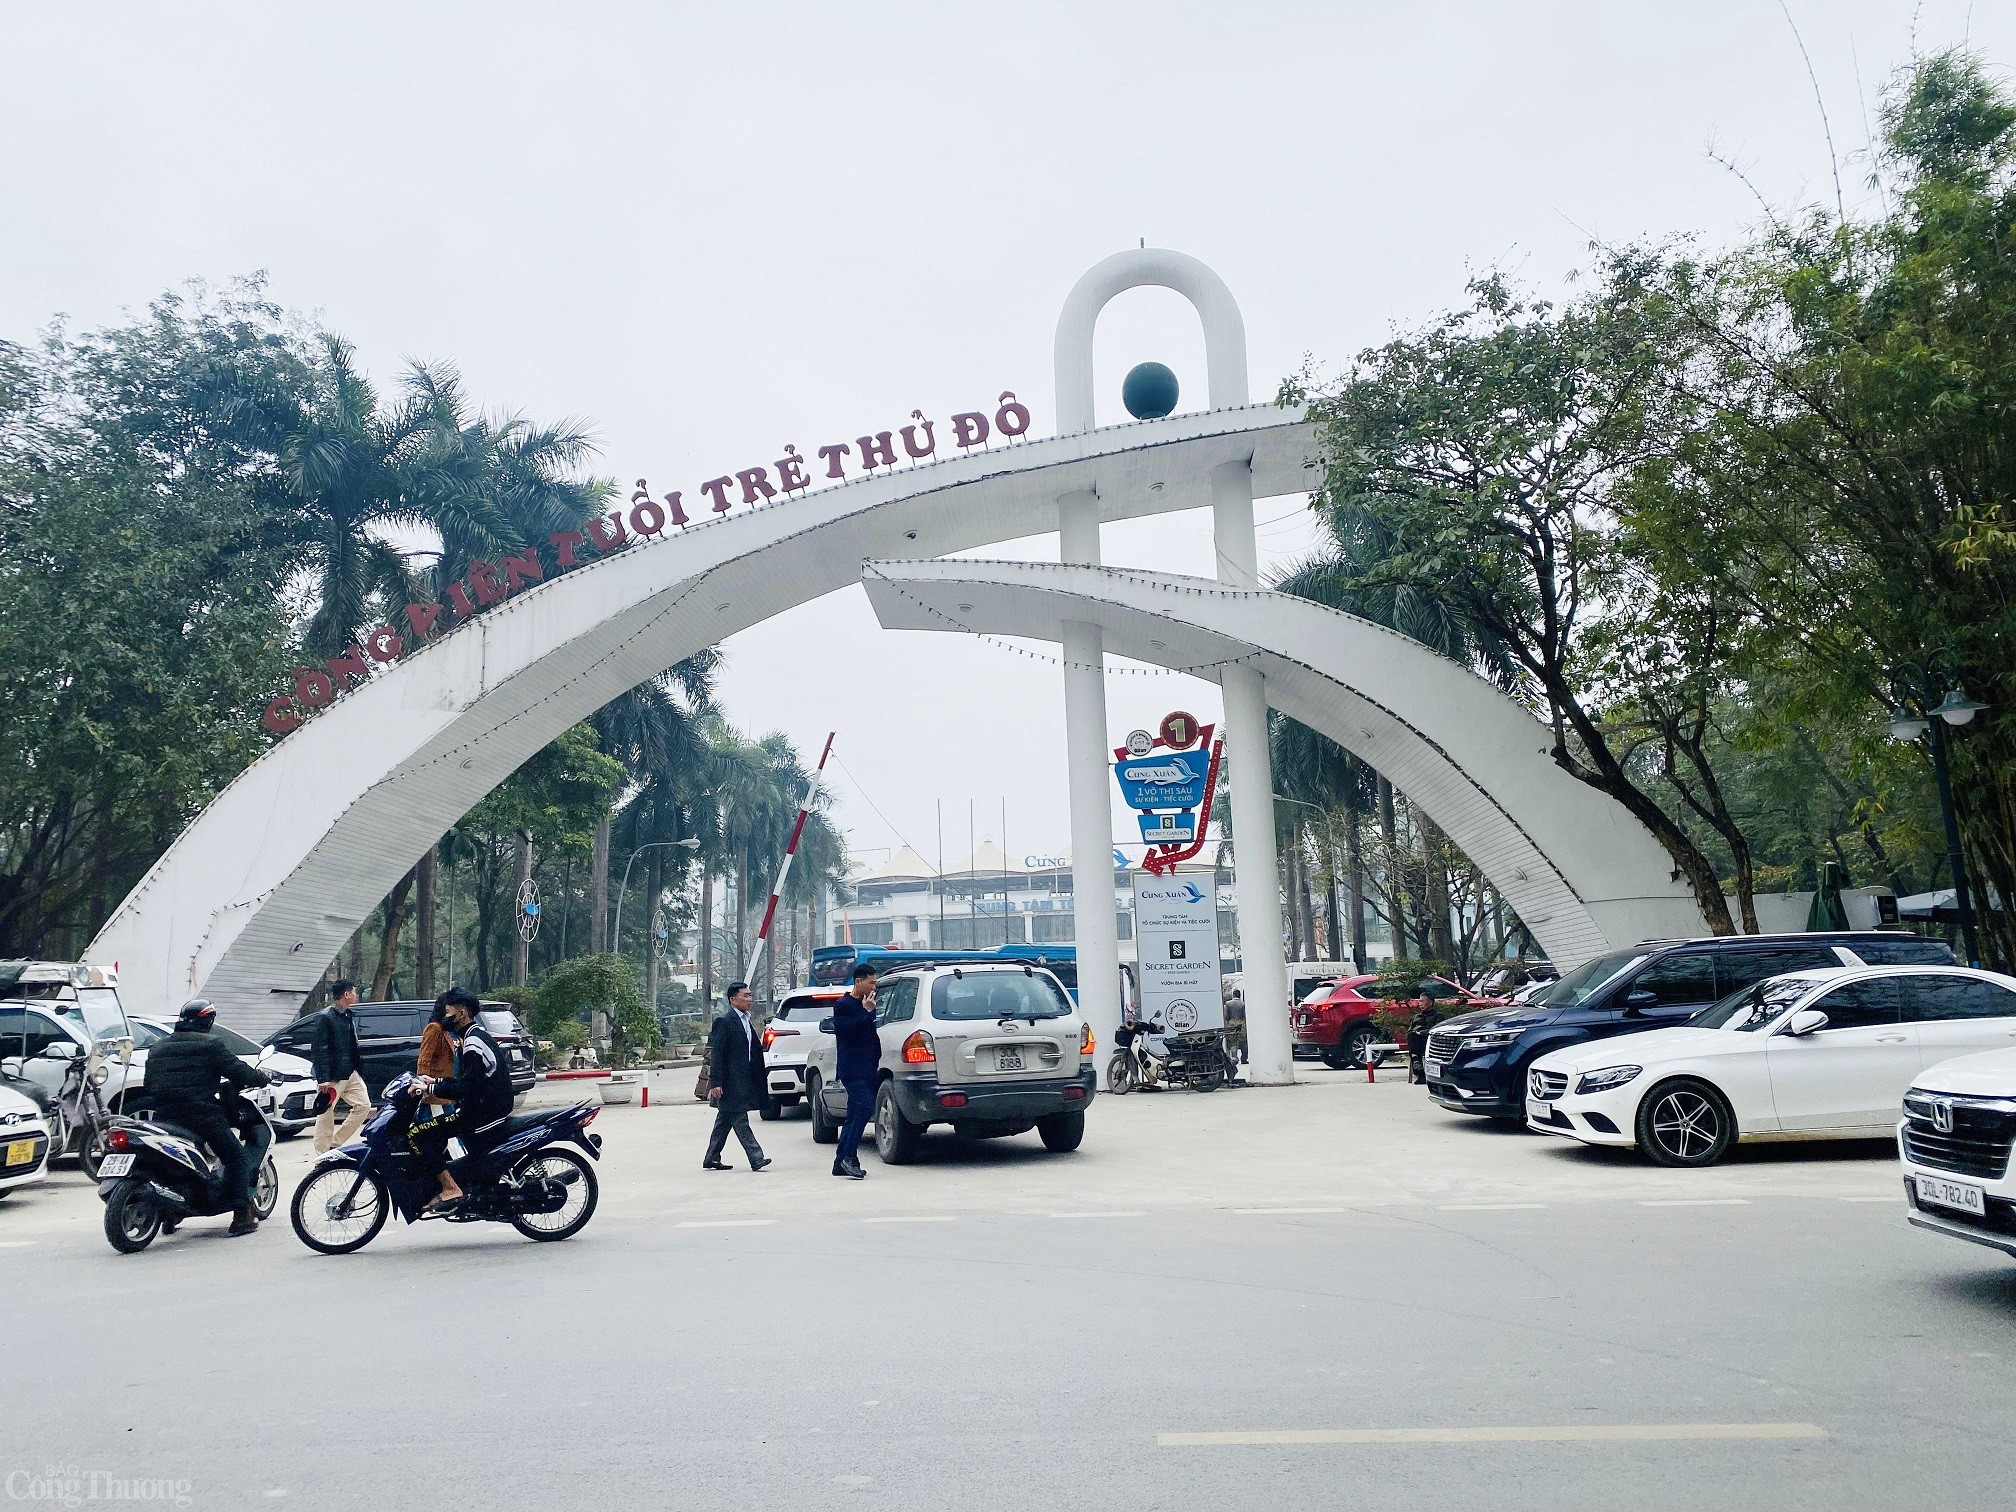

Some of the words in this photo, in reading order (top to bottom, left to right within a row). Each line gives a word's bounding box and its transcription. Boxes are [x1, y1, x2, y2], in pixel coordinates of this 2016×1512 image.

[263, 625, 404, 733] CÔNG
[551, 478, 690, 567] TUỔI
[700, 444, 810, 513] TRẺ
[818, 409, 936, 479] THỦ
[951, 391, 1031, 447] ĐÔ
[1168, 718, 1186, 743] 1
[1145, 962, 1174, 971] SECRET
[1176, 961, 1211, 970] GARDEN
